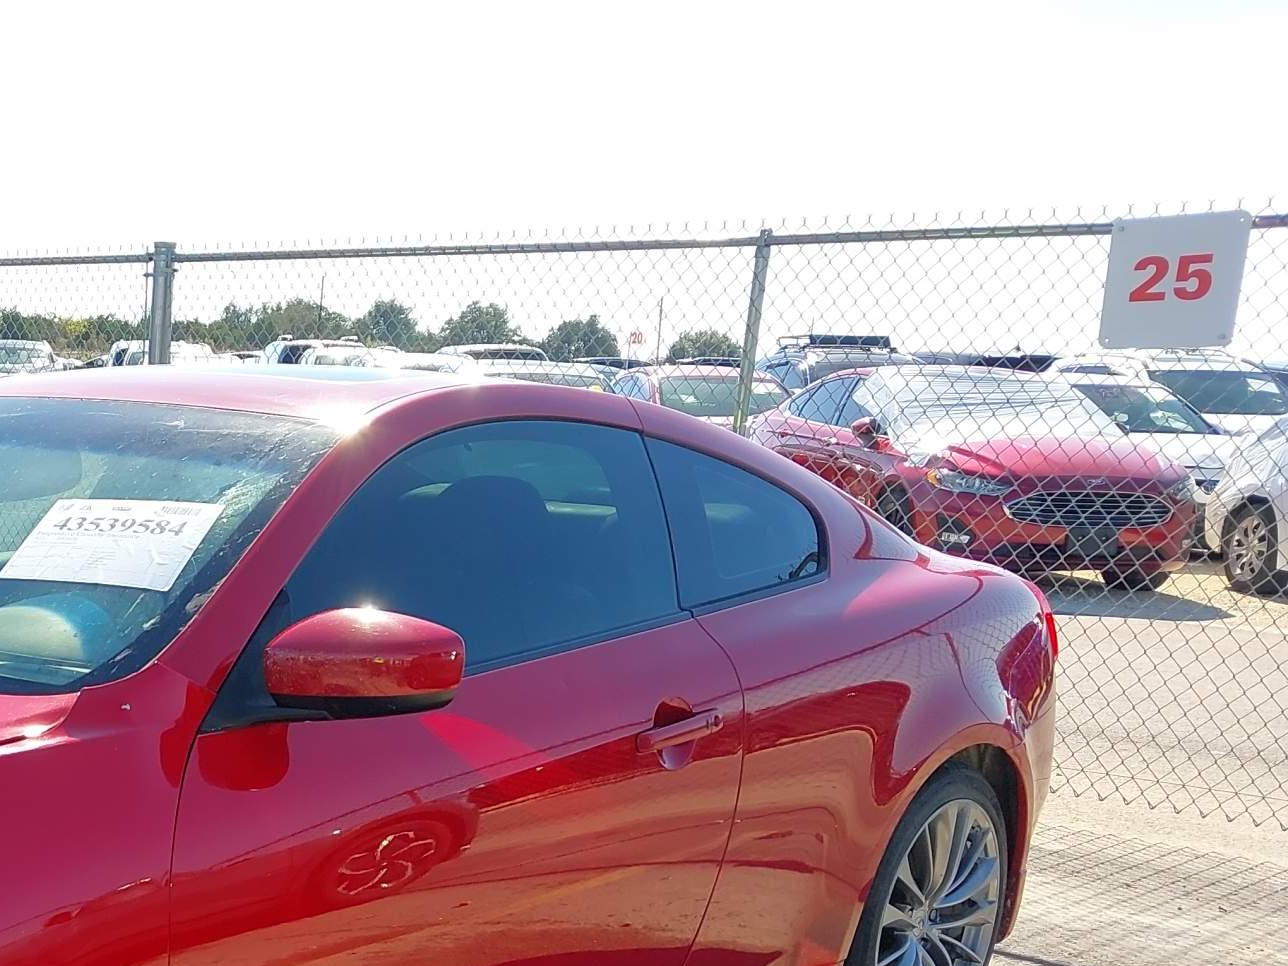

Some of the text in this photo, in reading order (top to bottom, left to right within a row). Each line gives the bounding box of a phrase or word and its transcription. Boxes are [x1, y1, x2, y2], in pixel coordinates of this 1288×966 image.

[1128, 254, 1214, 302] 25
[631, 331, 643, 344] 20
[54, 516, 188, 537] 43539584
